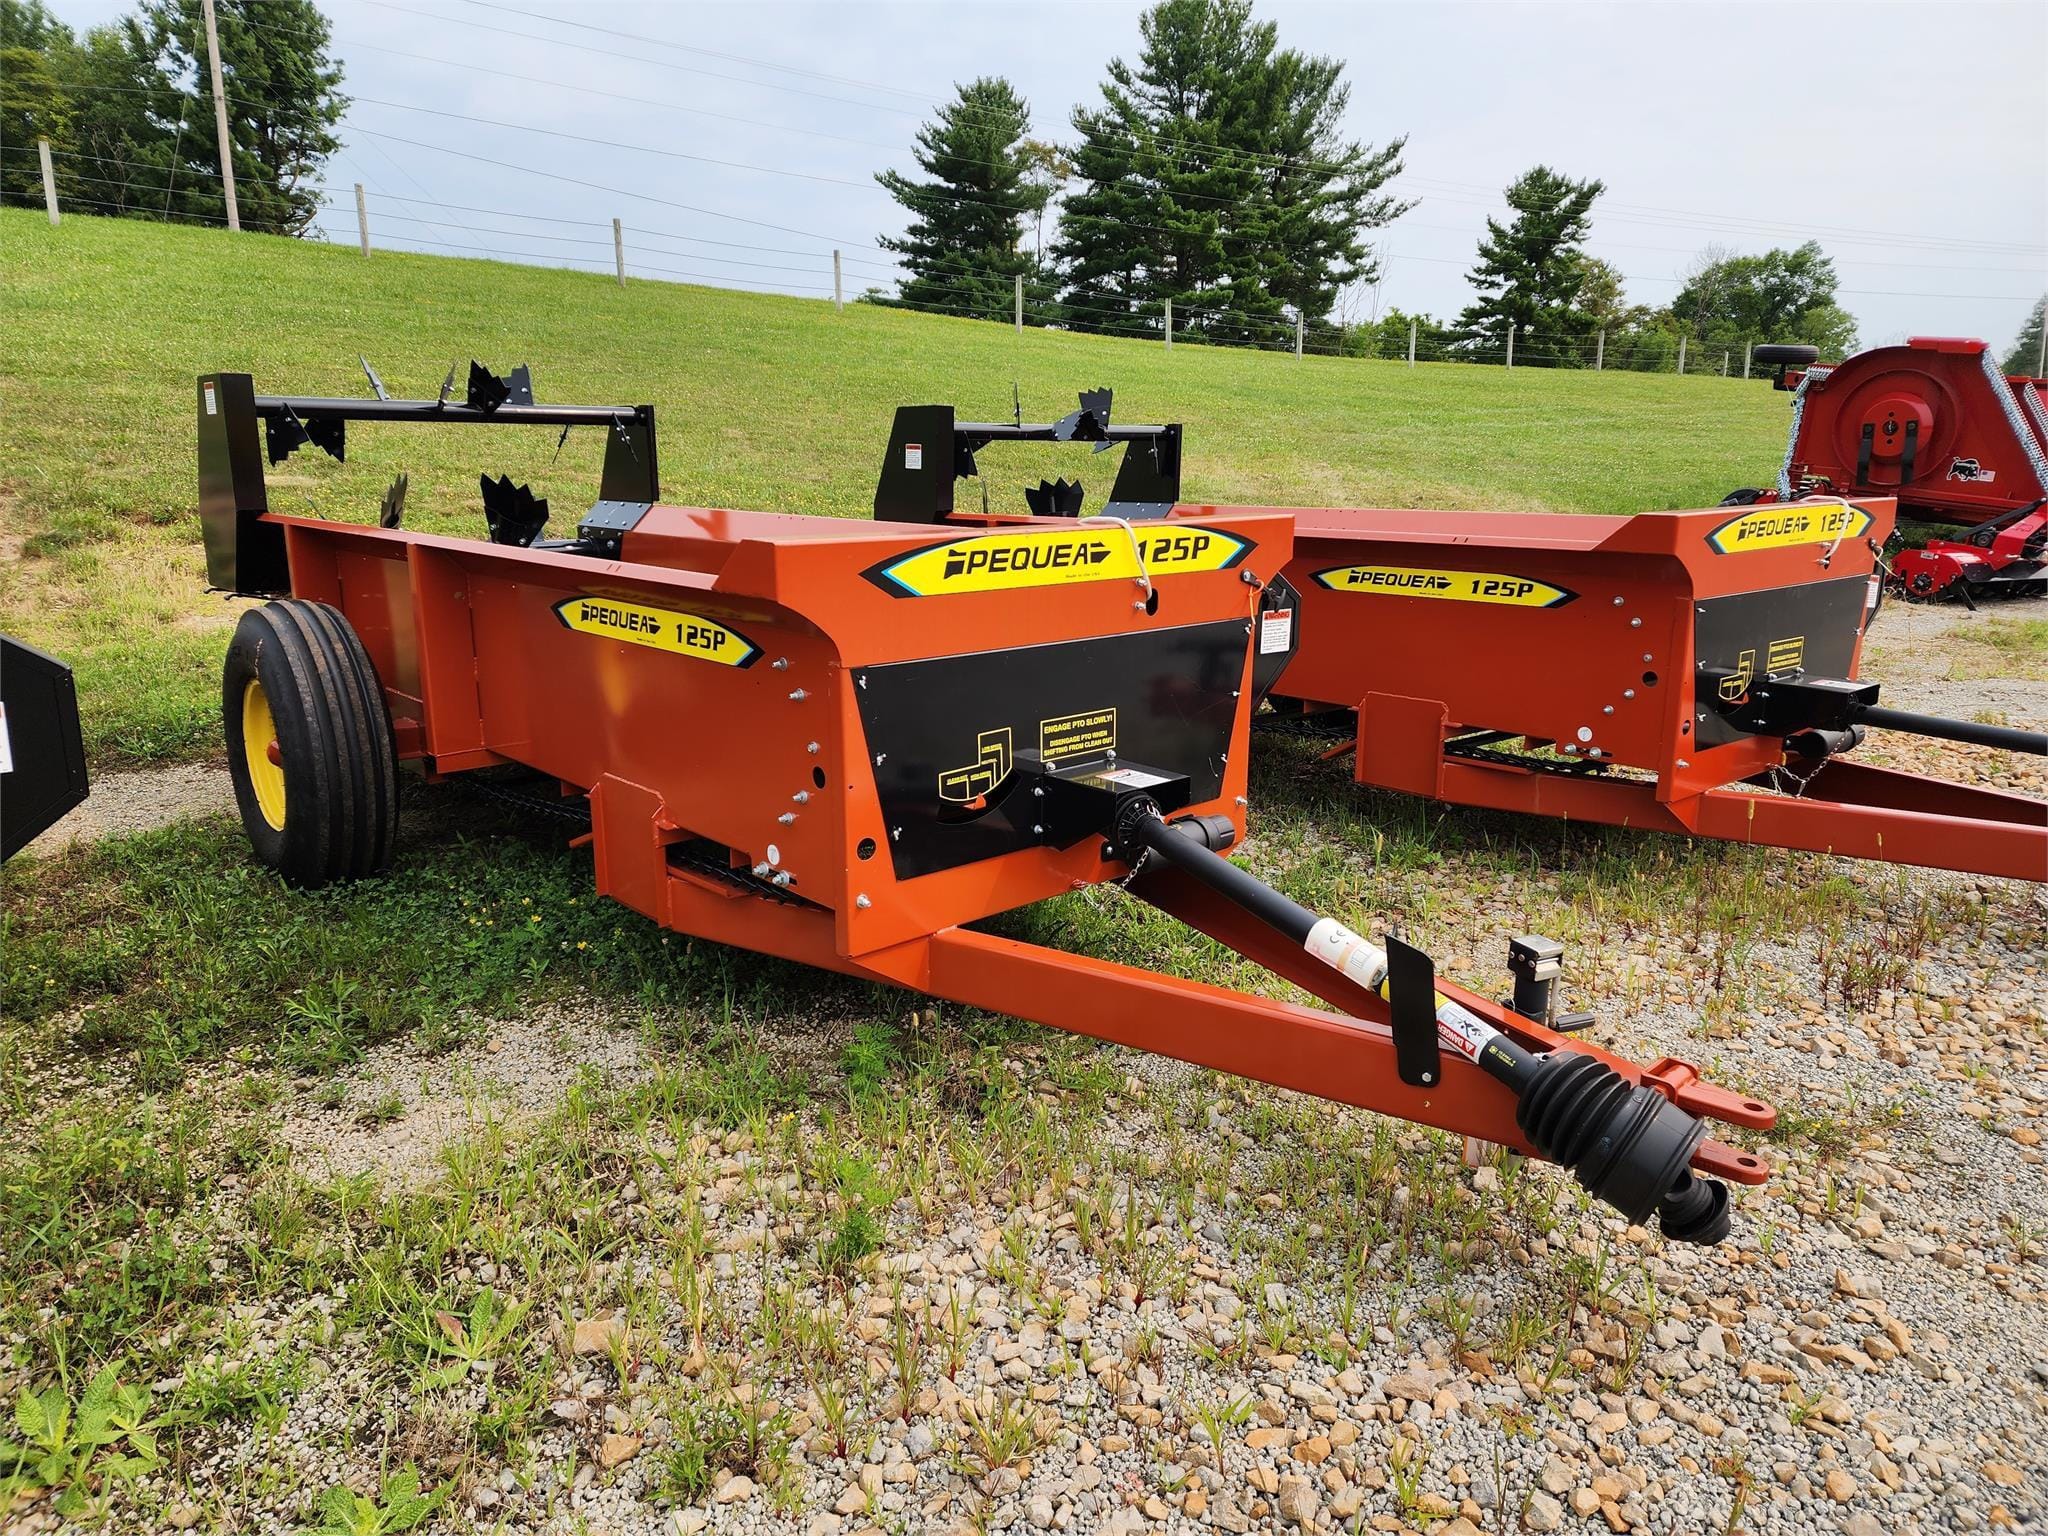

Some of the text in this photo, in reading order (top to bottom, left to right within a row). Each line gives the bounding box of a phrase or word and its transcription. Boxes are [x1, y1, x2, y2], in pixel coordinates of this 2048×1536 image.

[966, 536, 1210, 574] PEQUEA 125P
[1359, 571, 1534, 597] PEQUEA 125P
[590, 605, 726, 651] PEQUEA 125P
[1044, 722, 1071, 734] ENGAGE
[1072, 719, 1085, 729] PTO
[1081, 733, 1092, 741] PTO
[1438, 1023, 1464, 1047] DANGER
